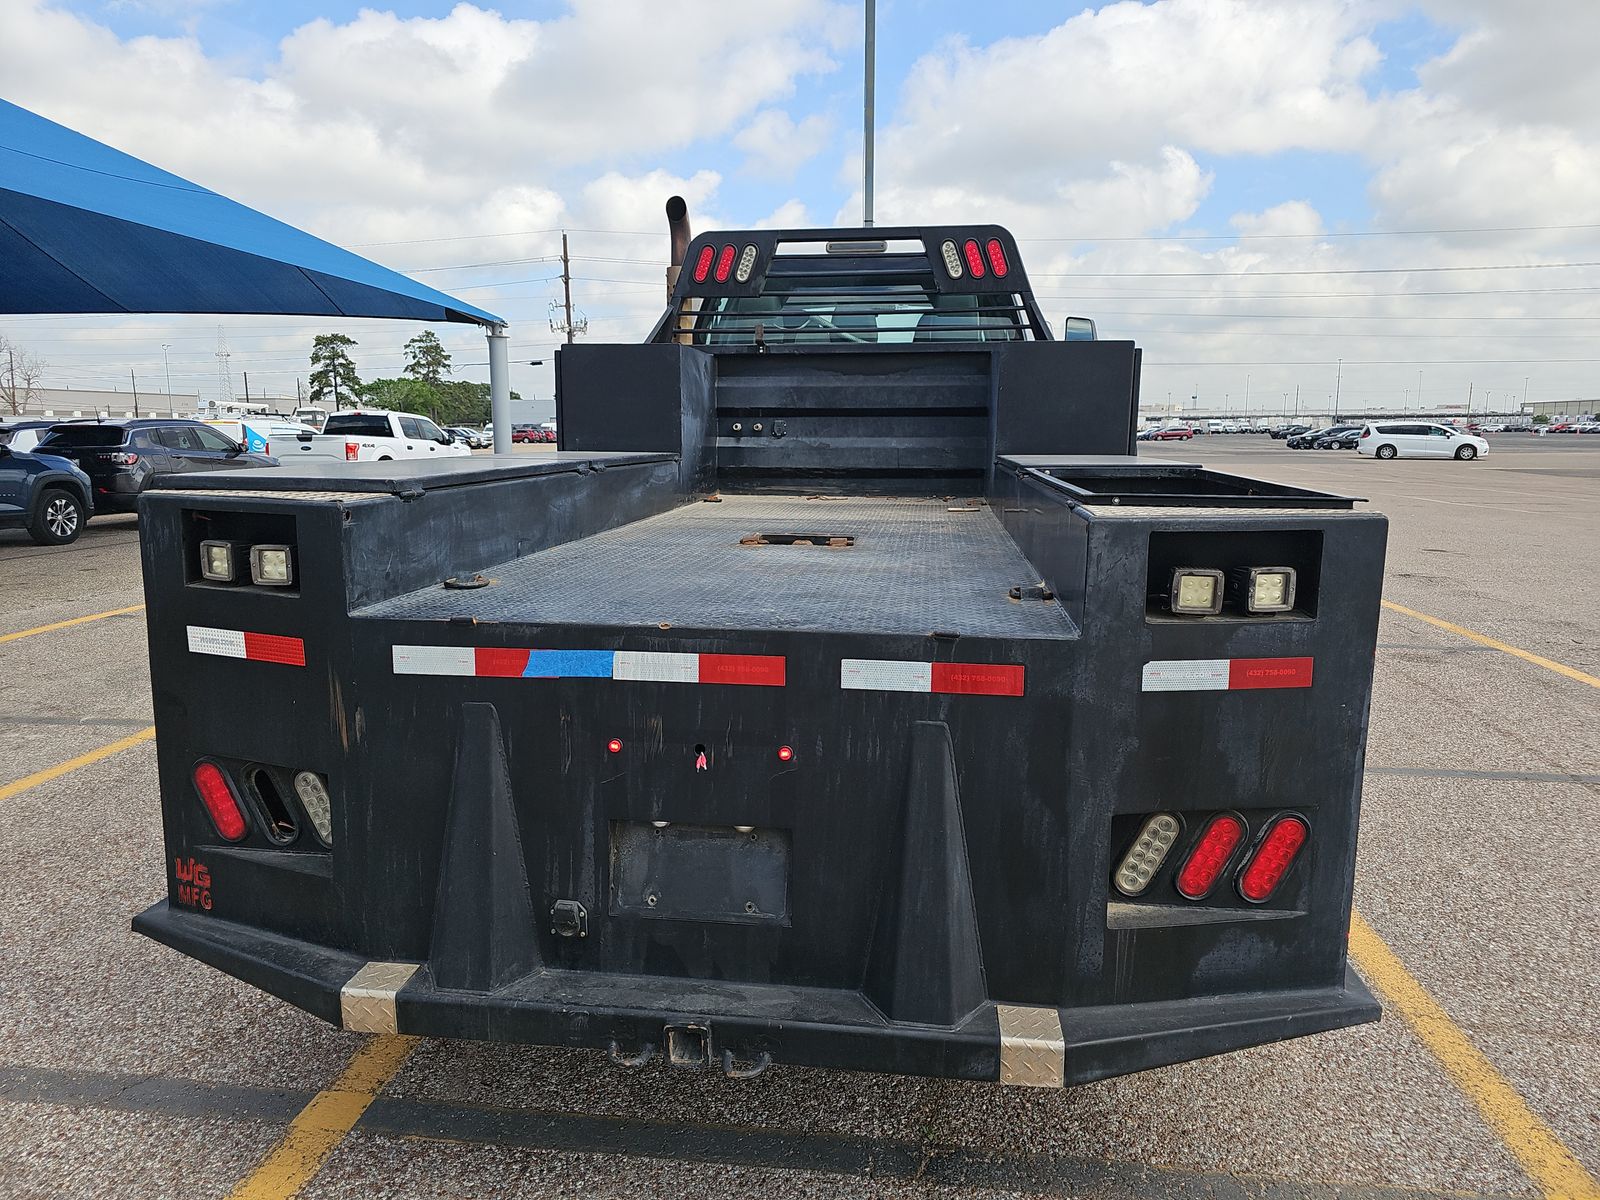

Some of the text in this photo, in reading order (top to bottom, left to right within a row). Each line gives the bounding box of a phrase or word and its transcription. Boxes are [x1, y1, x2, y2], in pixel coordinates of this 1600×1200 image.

[950, 674, 970, 682] (432)
[1246, 669, 1264, 677] (432)
[175, 857, 211, 888] WG
[178, 884, 213, 910] MFG
